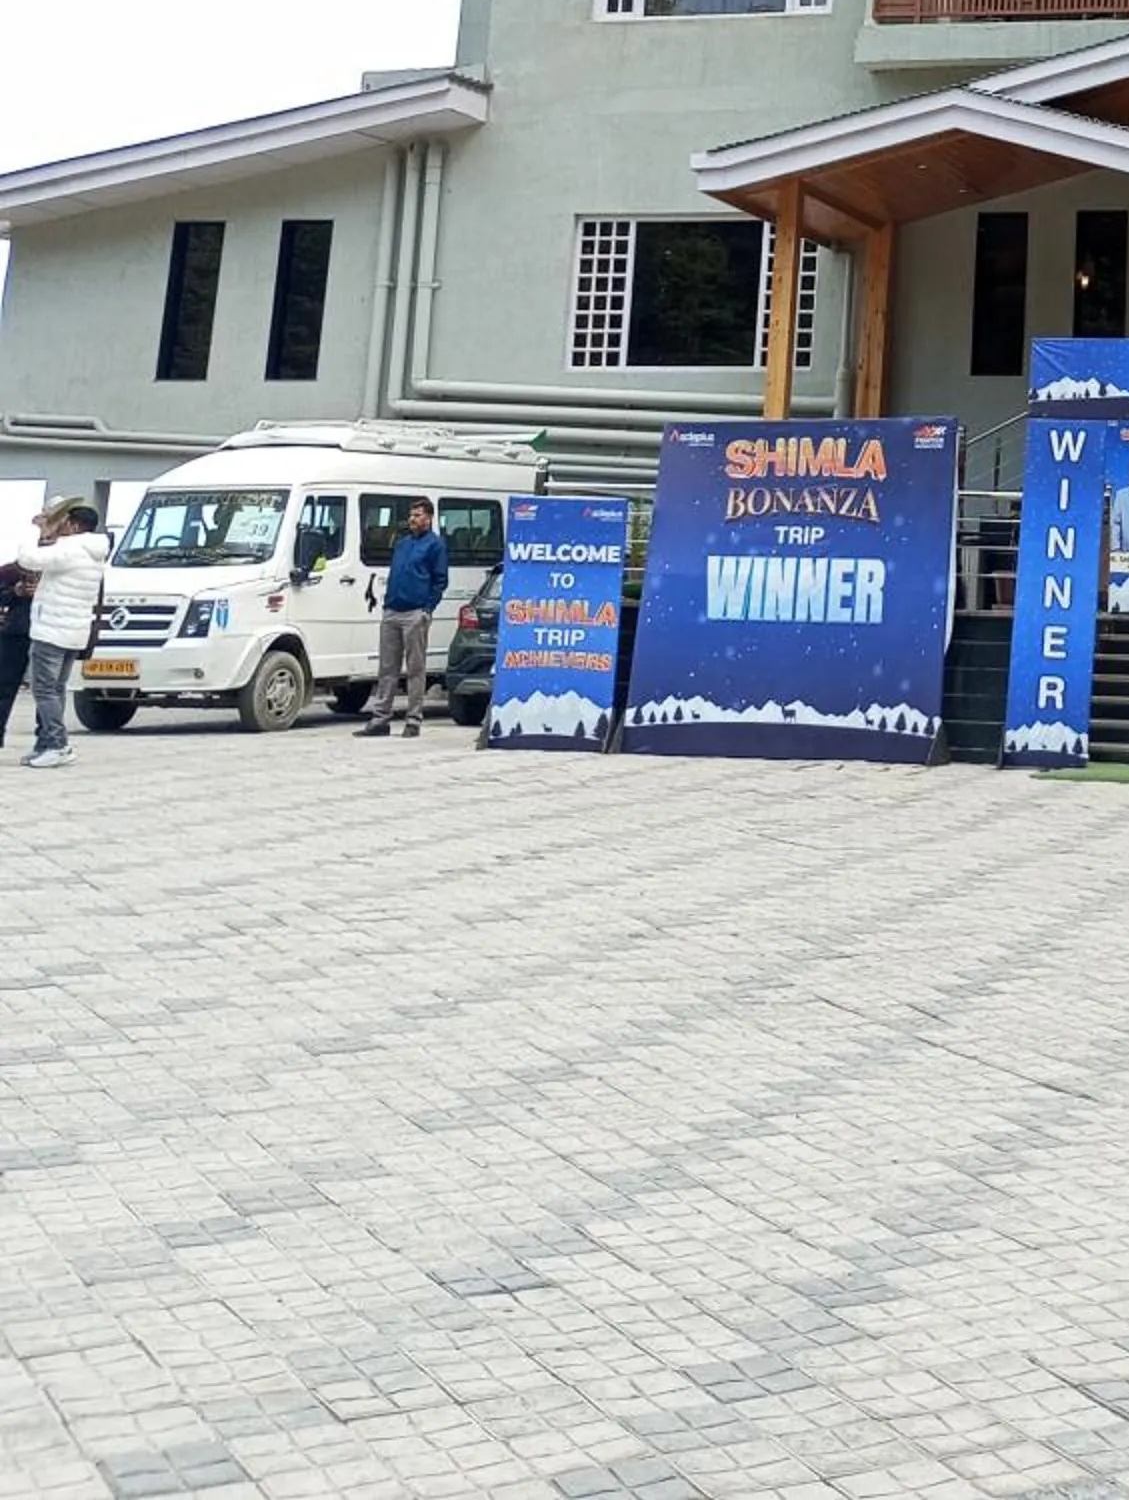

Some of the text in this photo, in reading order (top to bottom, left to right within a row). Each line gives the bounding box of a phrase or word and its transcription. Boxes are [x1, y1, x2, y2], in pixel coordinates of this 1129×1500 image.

[724, 436, 887, 481] SHIMLA
[725, 485, 880, 523] BONANZA
[774, 525, 825, 545] TRIP
[508, 542, 622, 564] WELCOME
[550, 572, 575, 589] TO
[1038, 429, 1087, 710] WINNER
[706, 554, 887, 626] WINNER
[505, 599, 619, 628] SHIMLA
[534, 628, 585, 647] TRIP
[504, 651, 613, 671] ACHIEVERS
